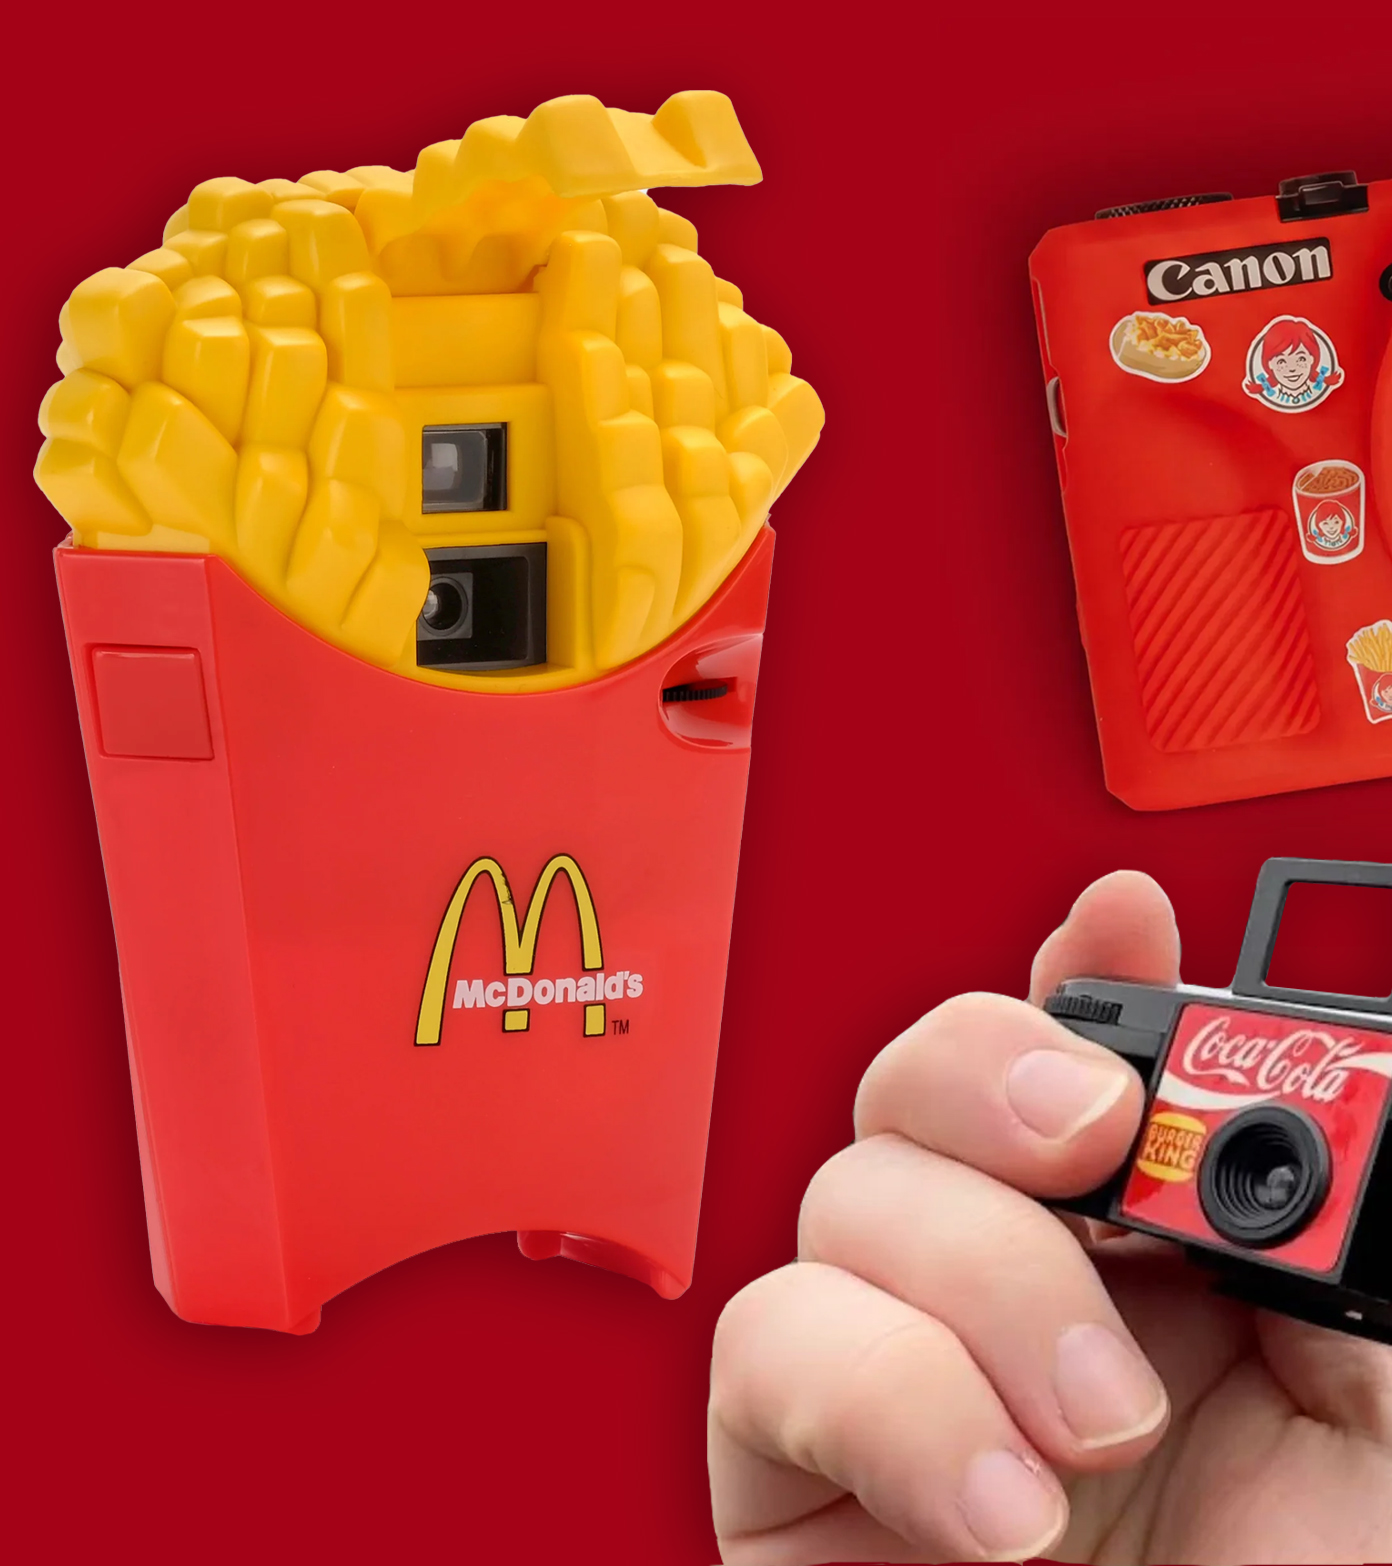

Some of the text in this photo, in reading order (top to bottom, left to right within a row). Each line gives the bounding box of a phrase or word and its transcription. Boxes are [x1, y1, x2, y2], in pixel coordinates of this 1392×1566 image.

[1147, 246, 1331, 300] Canon
[452, 970, 644, 1009] McDonald's
[612, 1019, 630, 1035] TM
[1183, 1016, 1363, 1103] Coca-Cola
[1148, 1123, 1203, 1151] BURGER
[1142, 1141, 1197, 1171] KING
